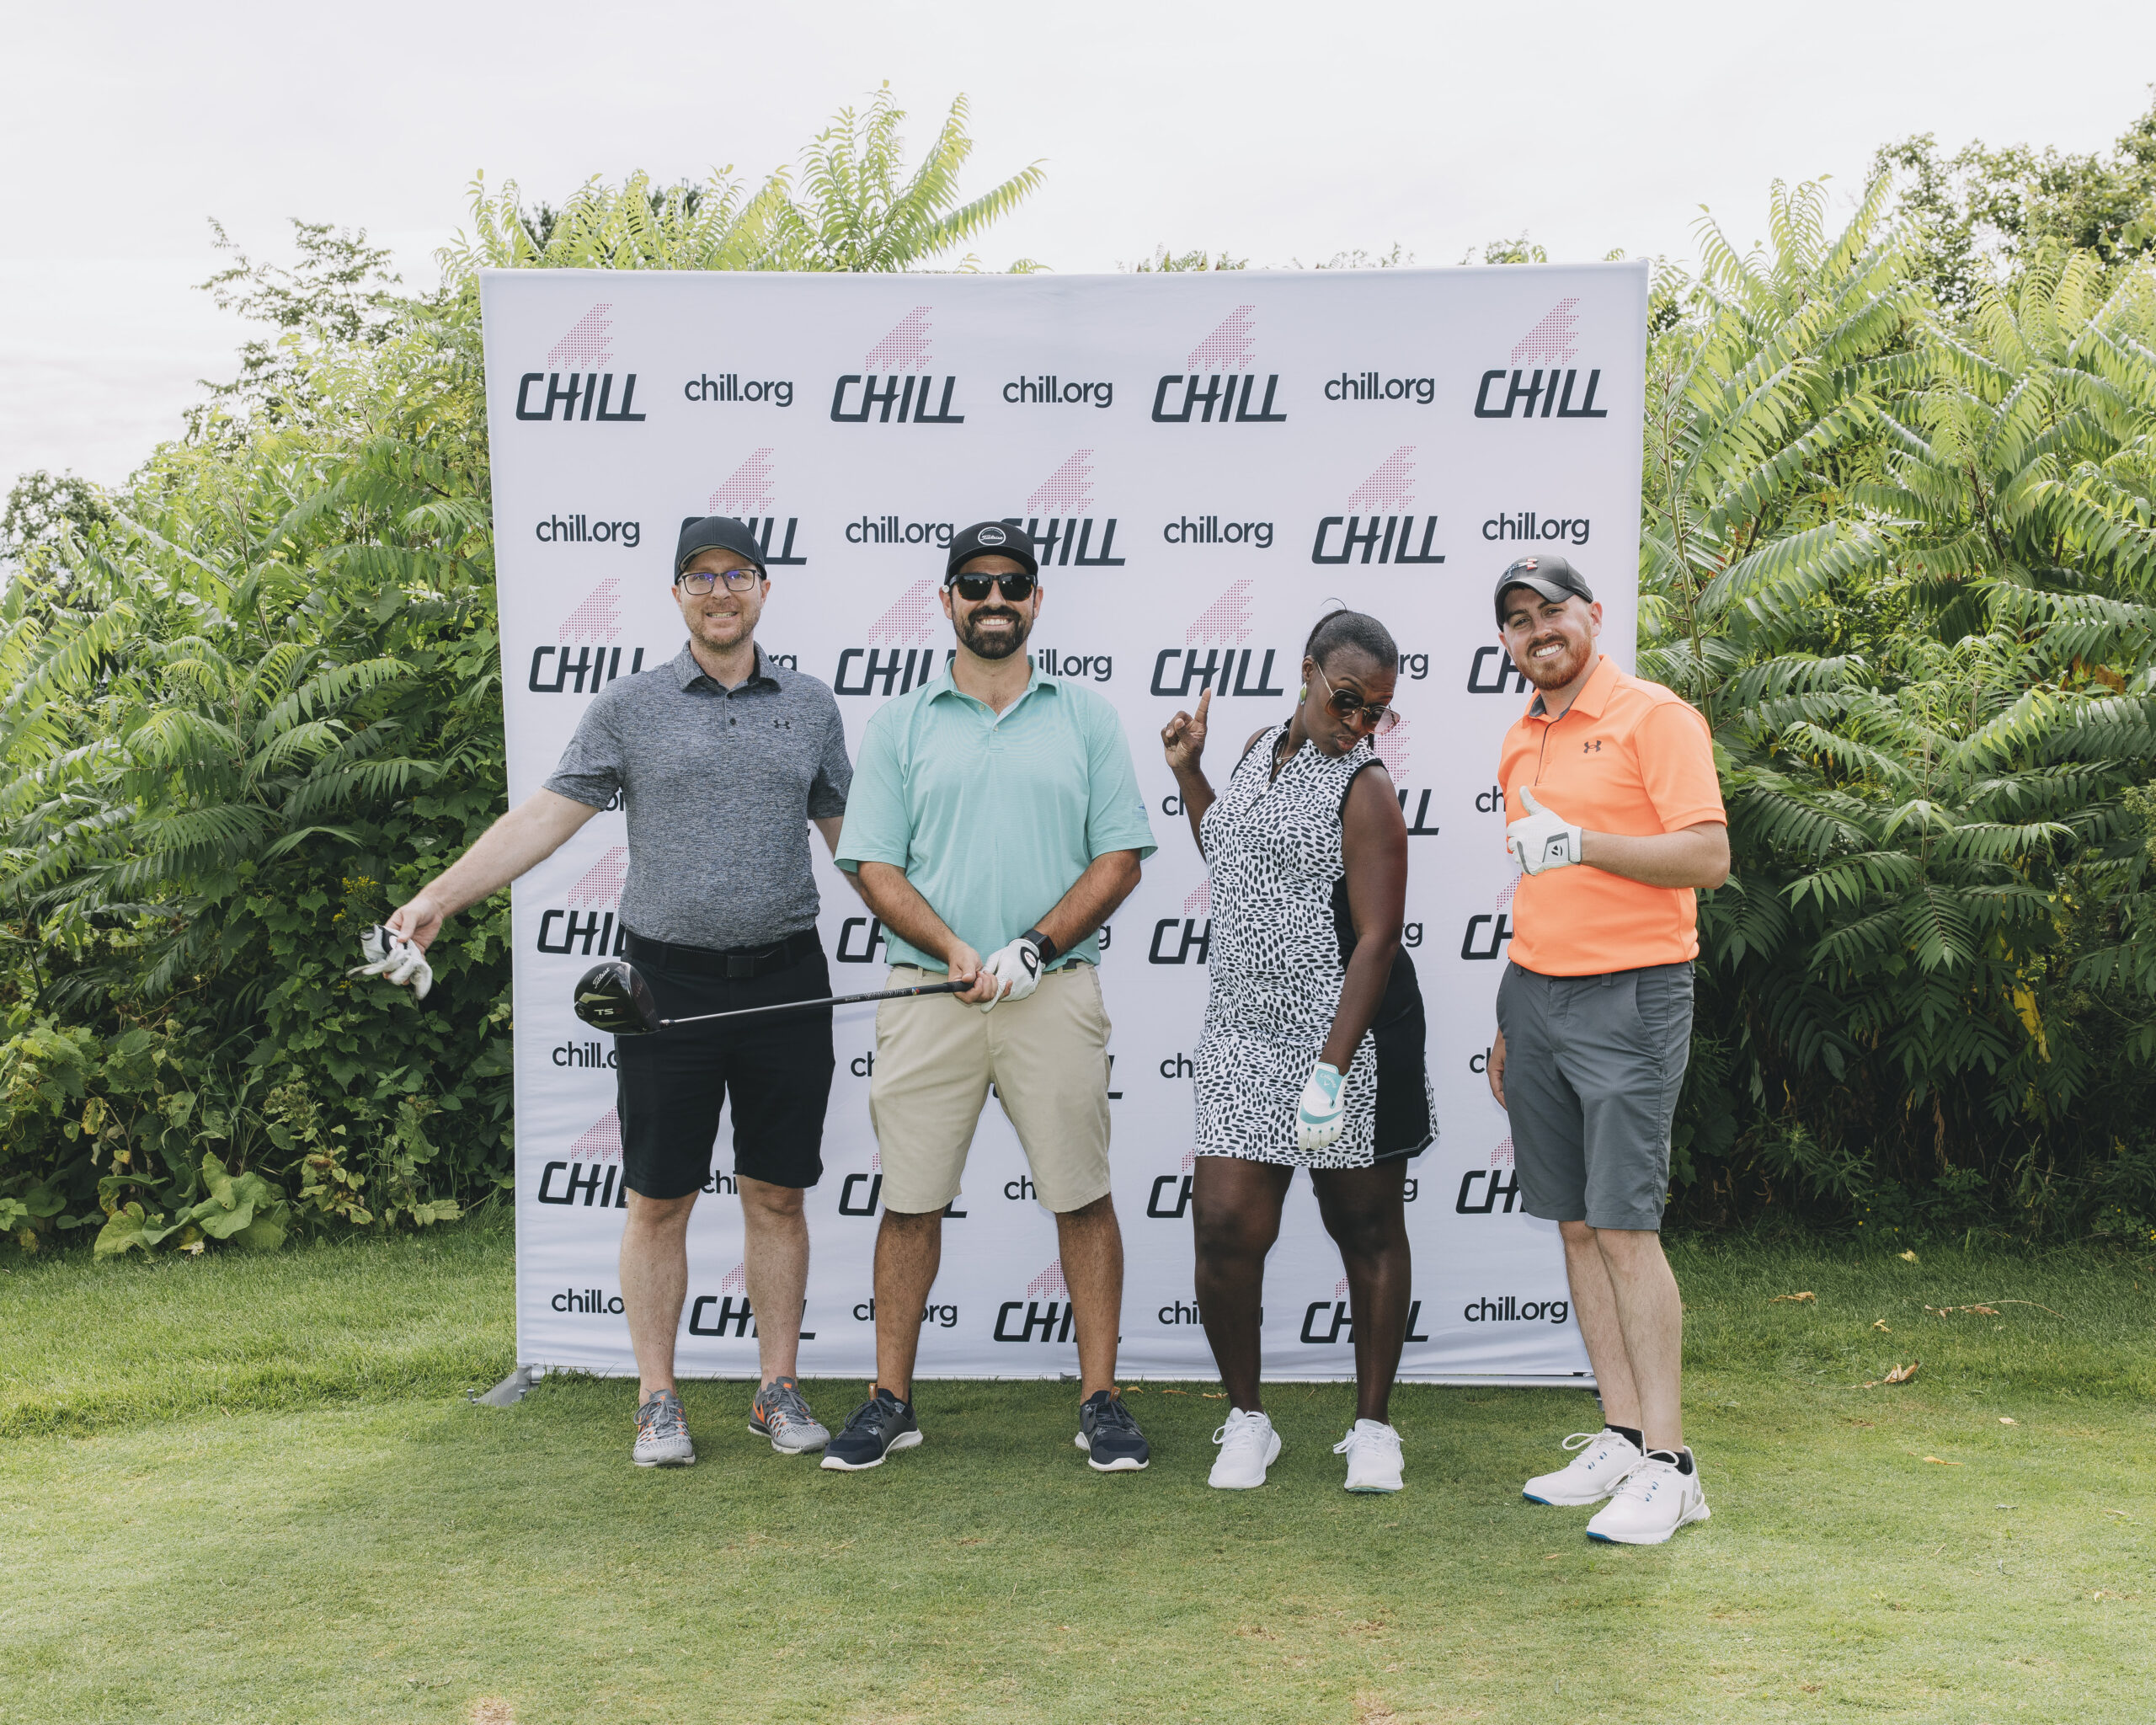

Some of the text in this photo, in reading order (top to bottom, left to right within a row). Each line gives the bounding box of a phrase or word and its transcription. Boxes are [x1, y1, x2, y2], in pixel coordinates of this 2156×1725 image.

[516, 373, 646, 421] CHILL
[685, 374, 792, 408] chill.org
[830, 376, 965, 423] CHILL
[1003, 375, 1113, 409] chill.org
[1151, 374, 1287, 422] CHILL
[1324, 372, 1434, 404] chill.org
[1474, 369, 1607, 418] CHILL
[536, 515, 640, 547] chill.org
[846, 515, 954, 548] chill.org
[1000, 518, 1125, 566] HILL
[1164, 515, 1273, 548] chill.org
[1311, 515, 1446, 563] CHILL
[1482, 512, 1589, 545] chill.org
[834, 649, 957, 696] CHIL
[1038, 649, 1112, 681] ill.org
[1150, 649, 1283, 697] CHILL
[552, 1041, 617, 1069] chill.o
[552, 1288, 625, 1314] chill.o
[1464, 1296, 1568, 1323] chill.org
[1300, 1300, 1429, 1343] CHL
